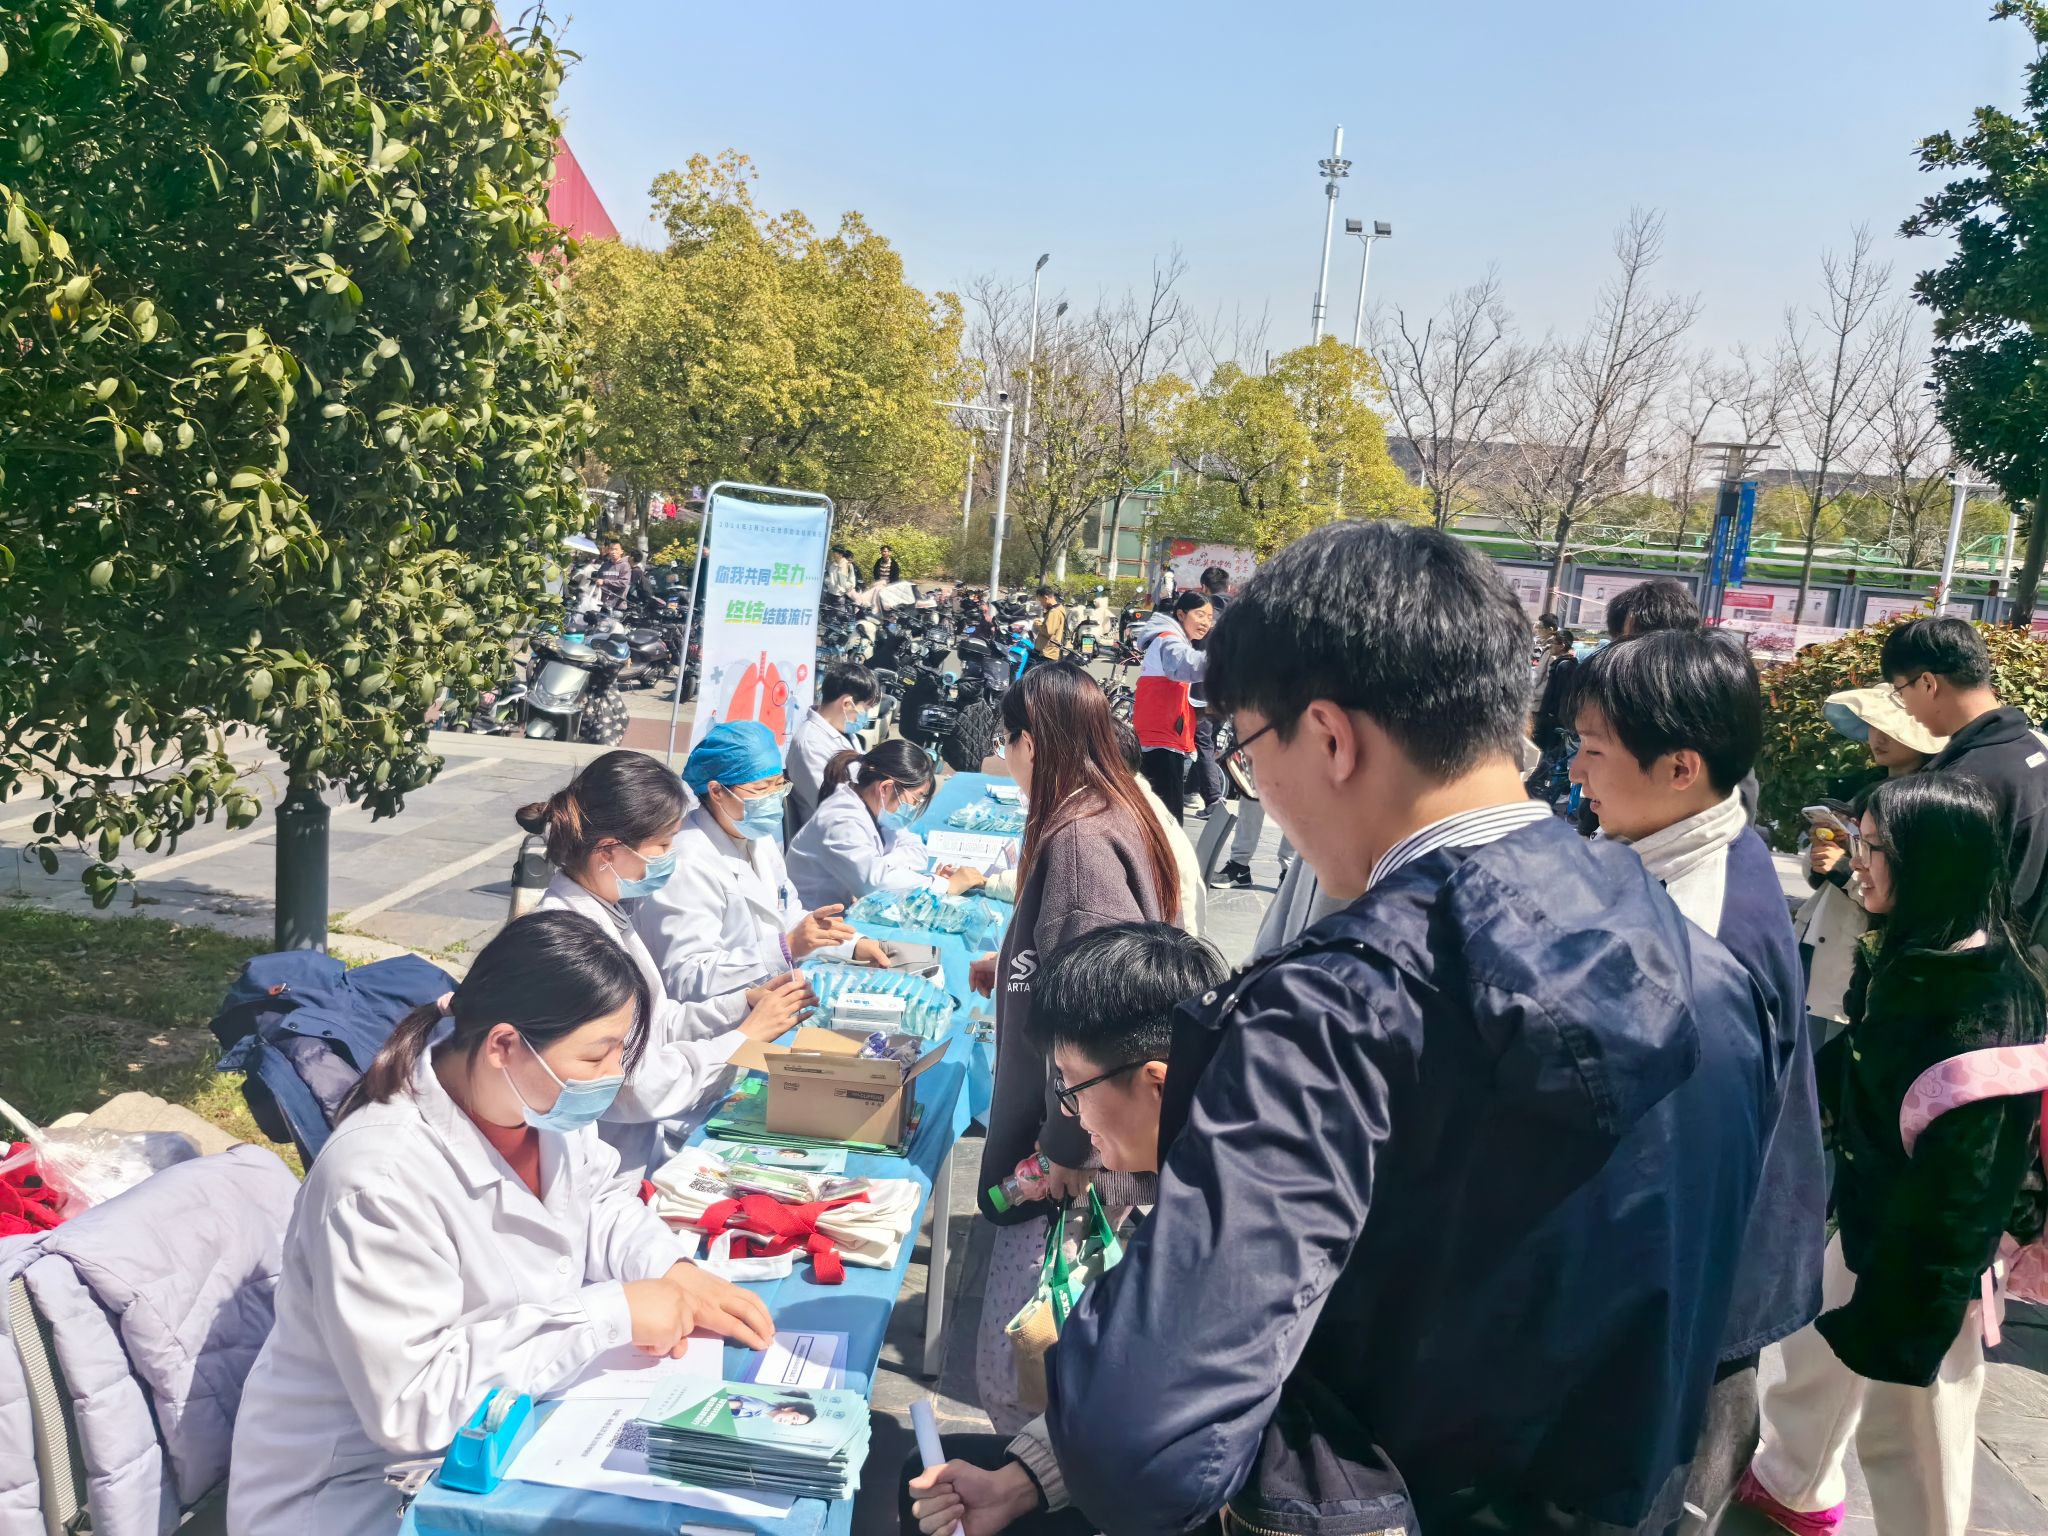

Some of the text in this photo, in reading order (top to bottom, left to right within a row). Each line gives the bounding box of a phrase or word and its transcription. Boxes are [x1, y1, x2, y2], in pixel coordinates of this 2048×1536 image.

[725, 600, 813, 626] 终结结核流行
